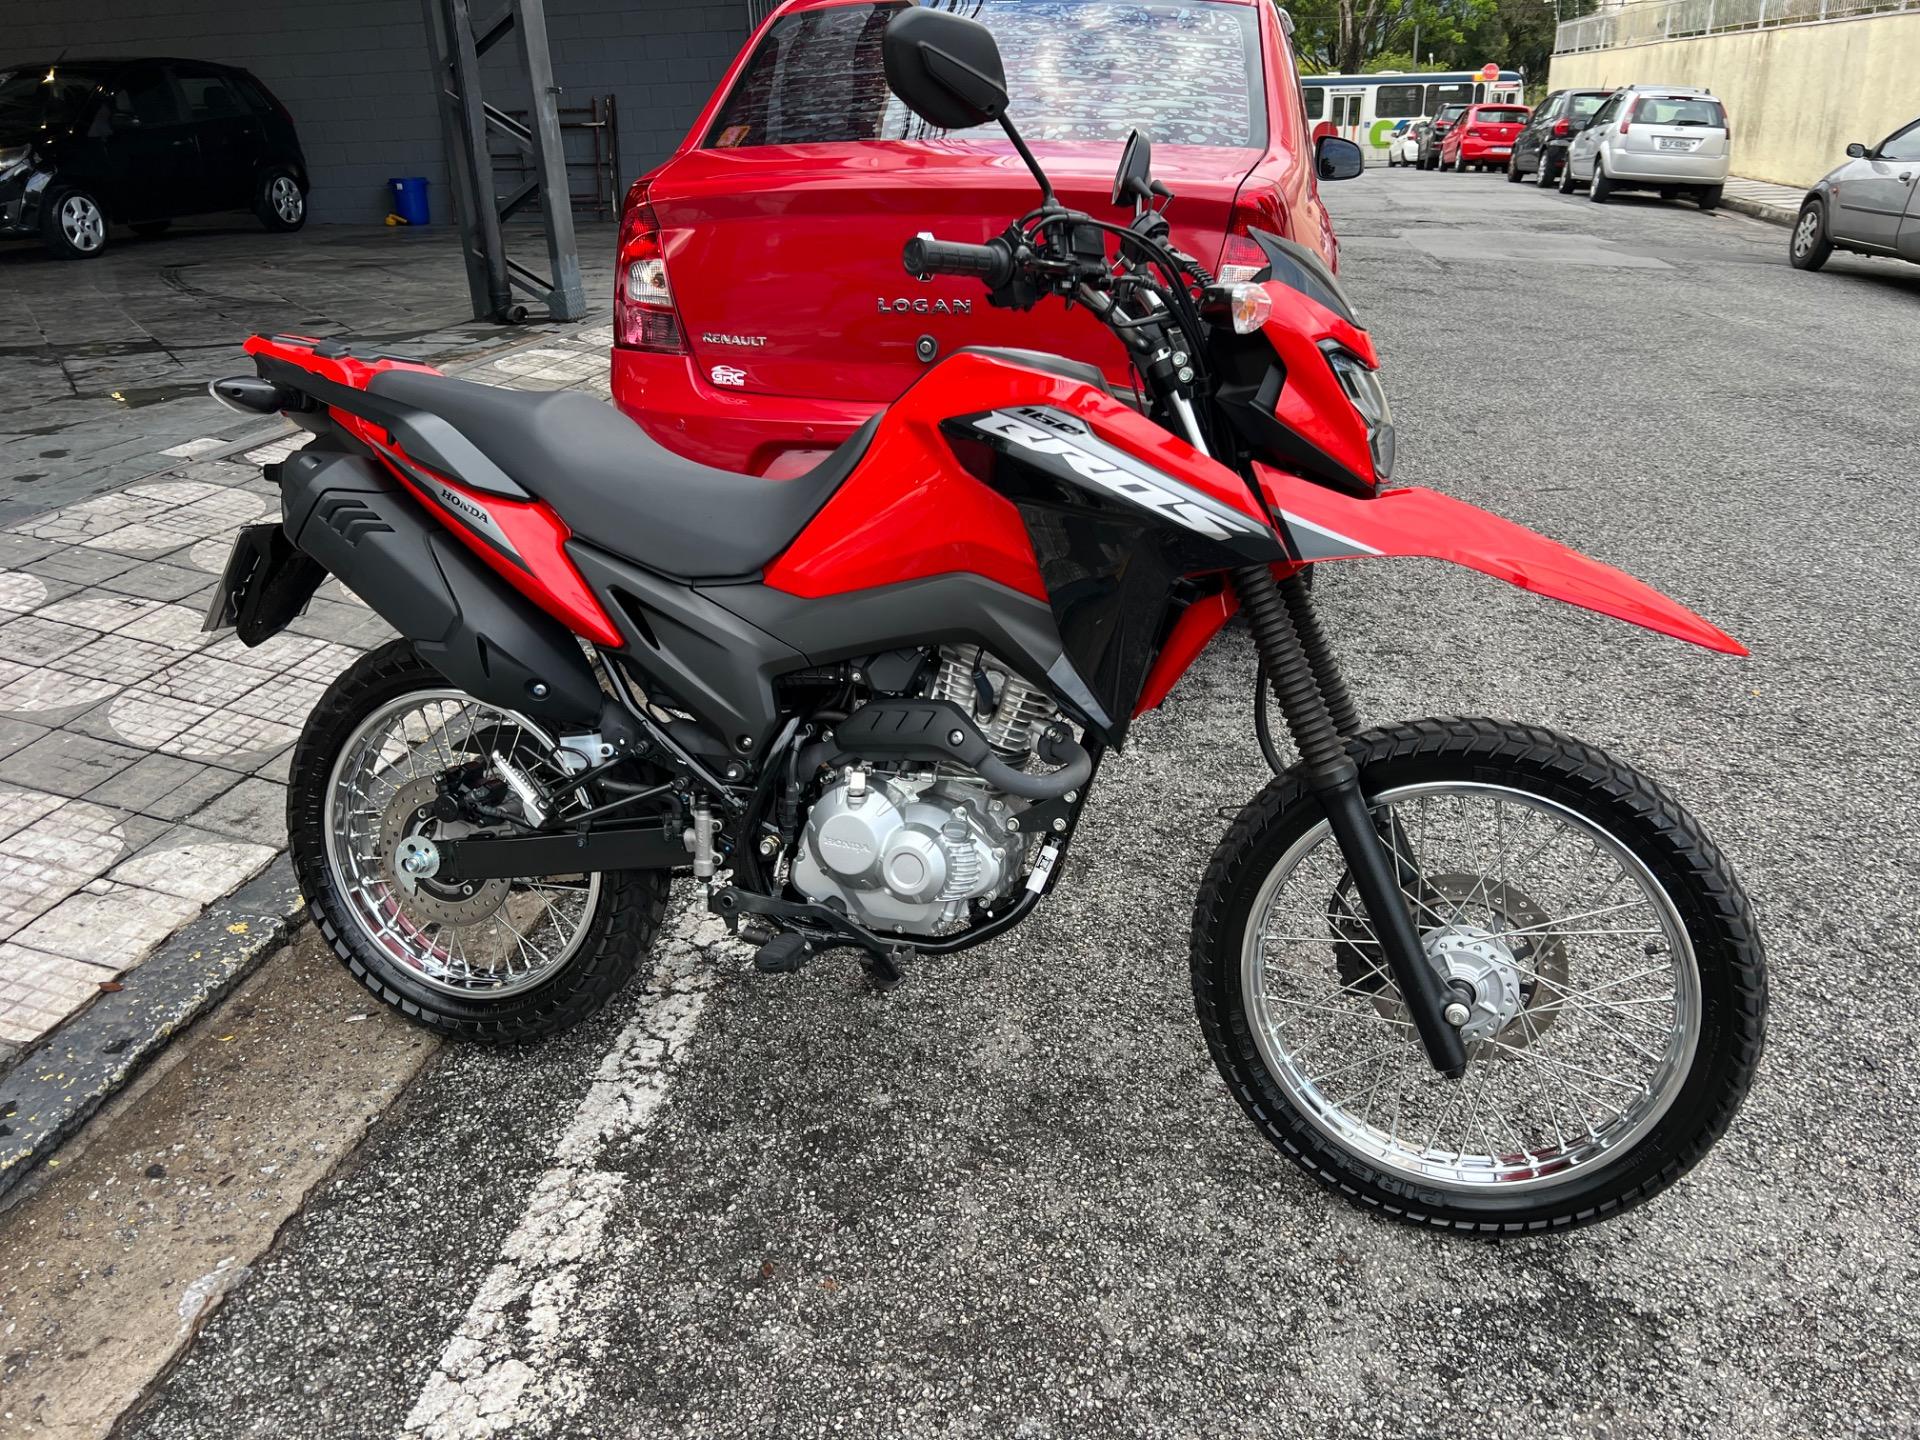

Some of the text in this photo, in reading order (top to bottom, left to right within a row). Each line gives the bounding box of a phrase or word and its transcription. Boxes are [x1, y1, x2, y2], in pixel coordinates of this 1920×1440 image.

[877, 297, 972, 314] LOGAN
[702, 332, 767, 347] RENAULT
[711, 370, 745, 382] GRC
[1016, 407, 1087, 436] 160
[972, 410, 1251, 541] BROS
[441, 489, 489, 524] HONDA
[823, 836, 873, 854] HONDA
[1289, 1116, 1447, 1209] PIRELLI
